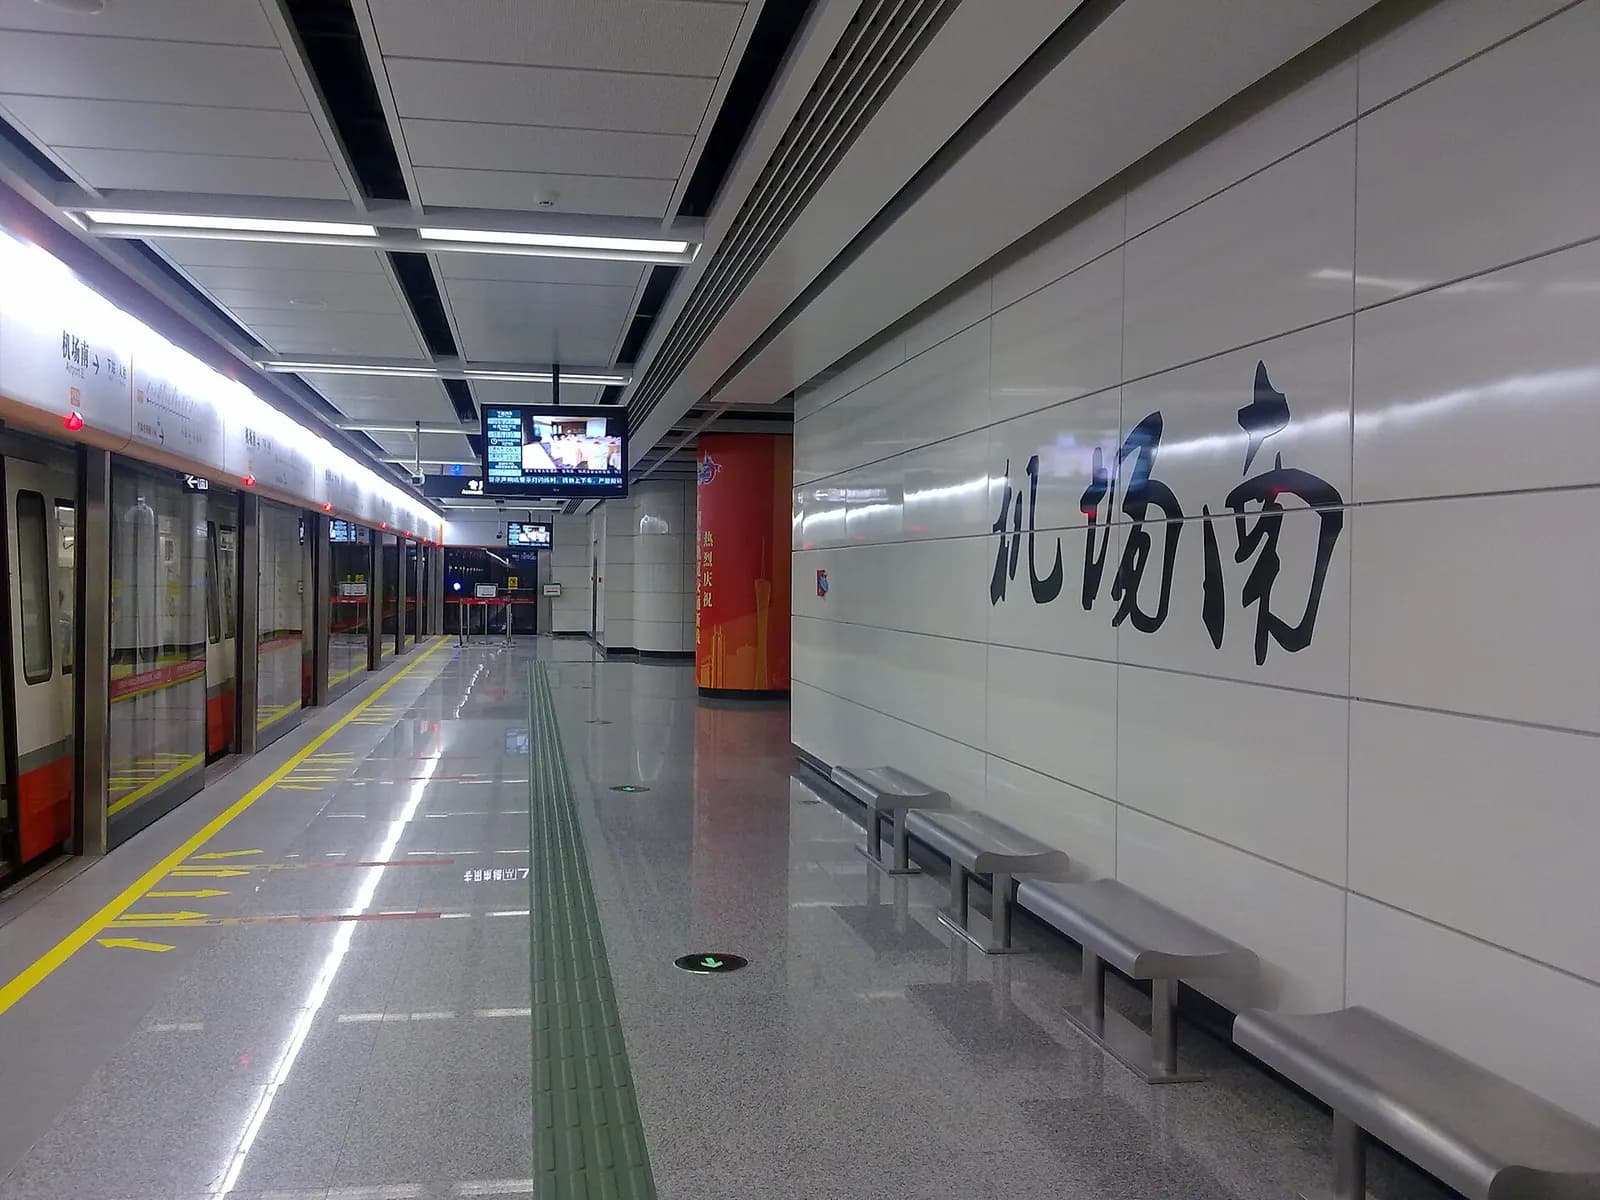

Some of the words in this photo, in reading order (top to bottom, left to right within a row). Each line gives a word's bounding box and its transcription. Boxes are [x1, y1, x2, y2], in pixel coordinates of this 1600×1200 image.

[62, 329, 89, 369] 机场南
[990, 360, 1344, 666] 机场南
[702, 530, 714, 608] 热烈庆祝
